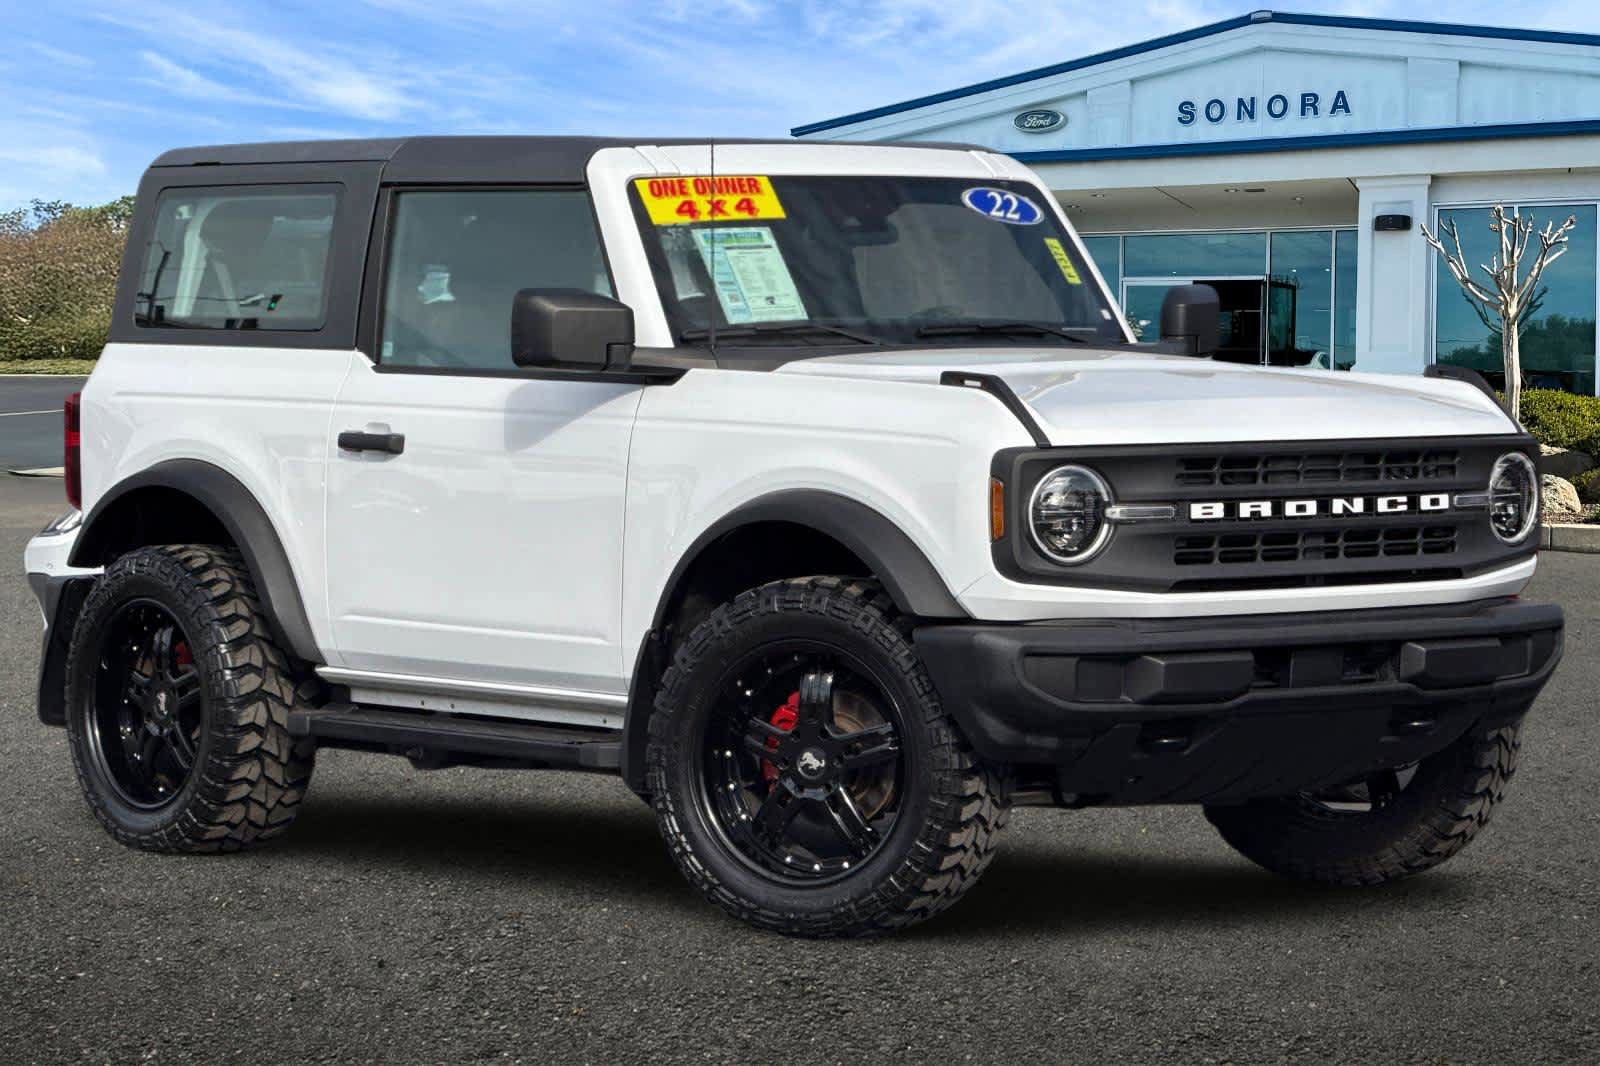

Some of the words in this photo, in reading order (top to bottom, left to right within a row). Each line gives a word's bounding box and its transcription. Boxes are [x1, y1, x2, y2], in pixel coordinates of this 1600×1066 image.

[1177, 90, 1352, 126] SONORA
[648, 179, 689, 198] ONE
[692, 177, 762, 195] OWNER
[987, 191, 1021, 220] 22
[1190, 493, 1450, 519] BRONCO
